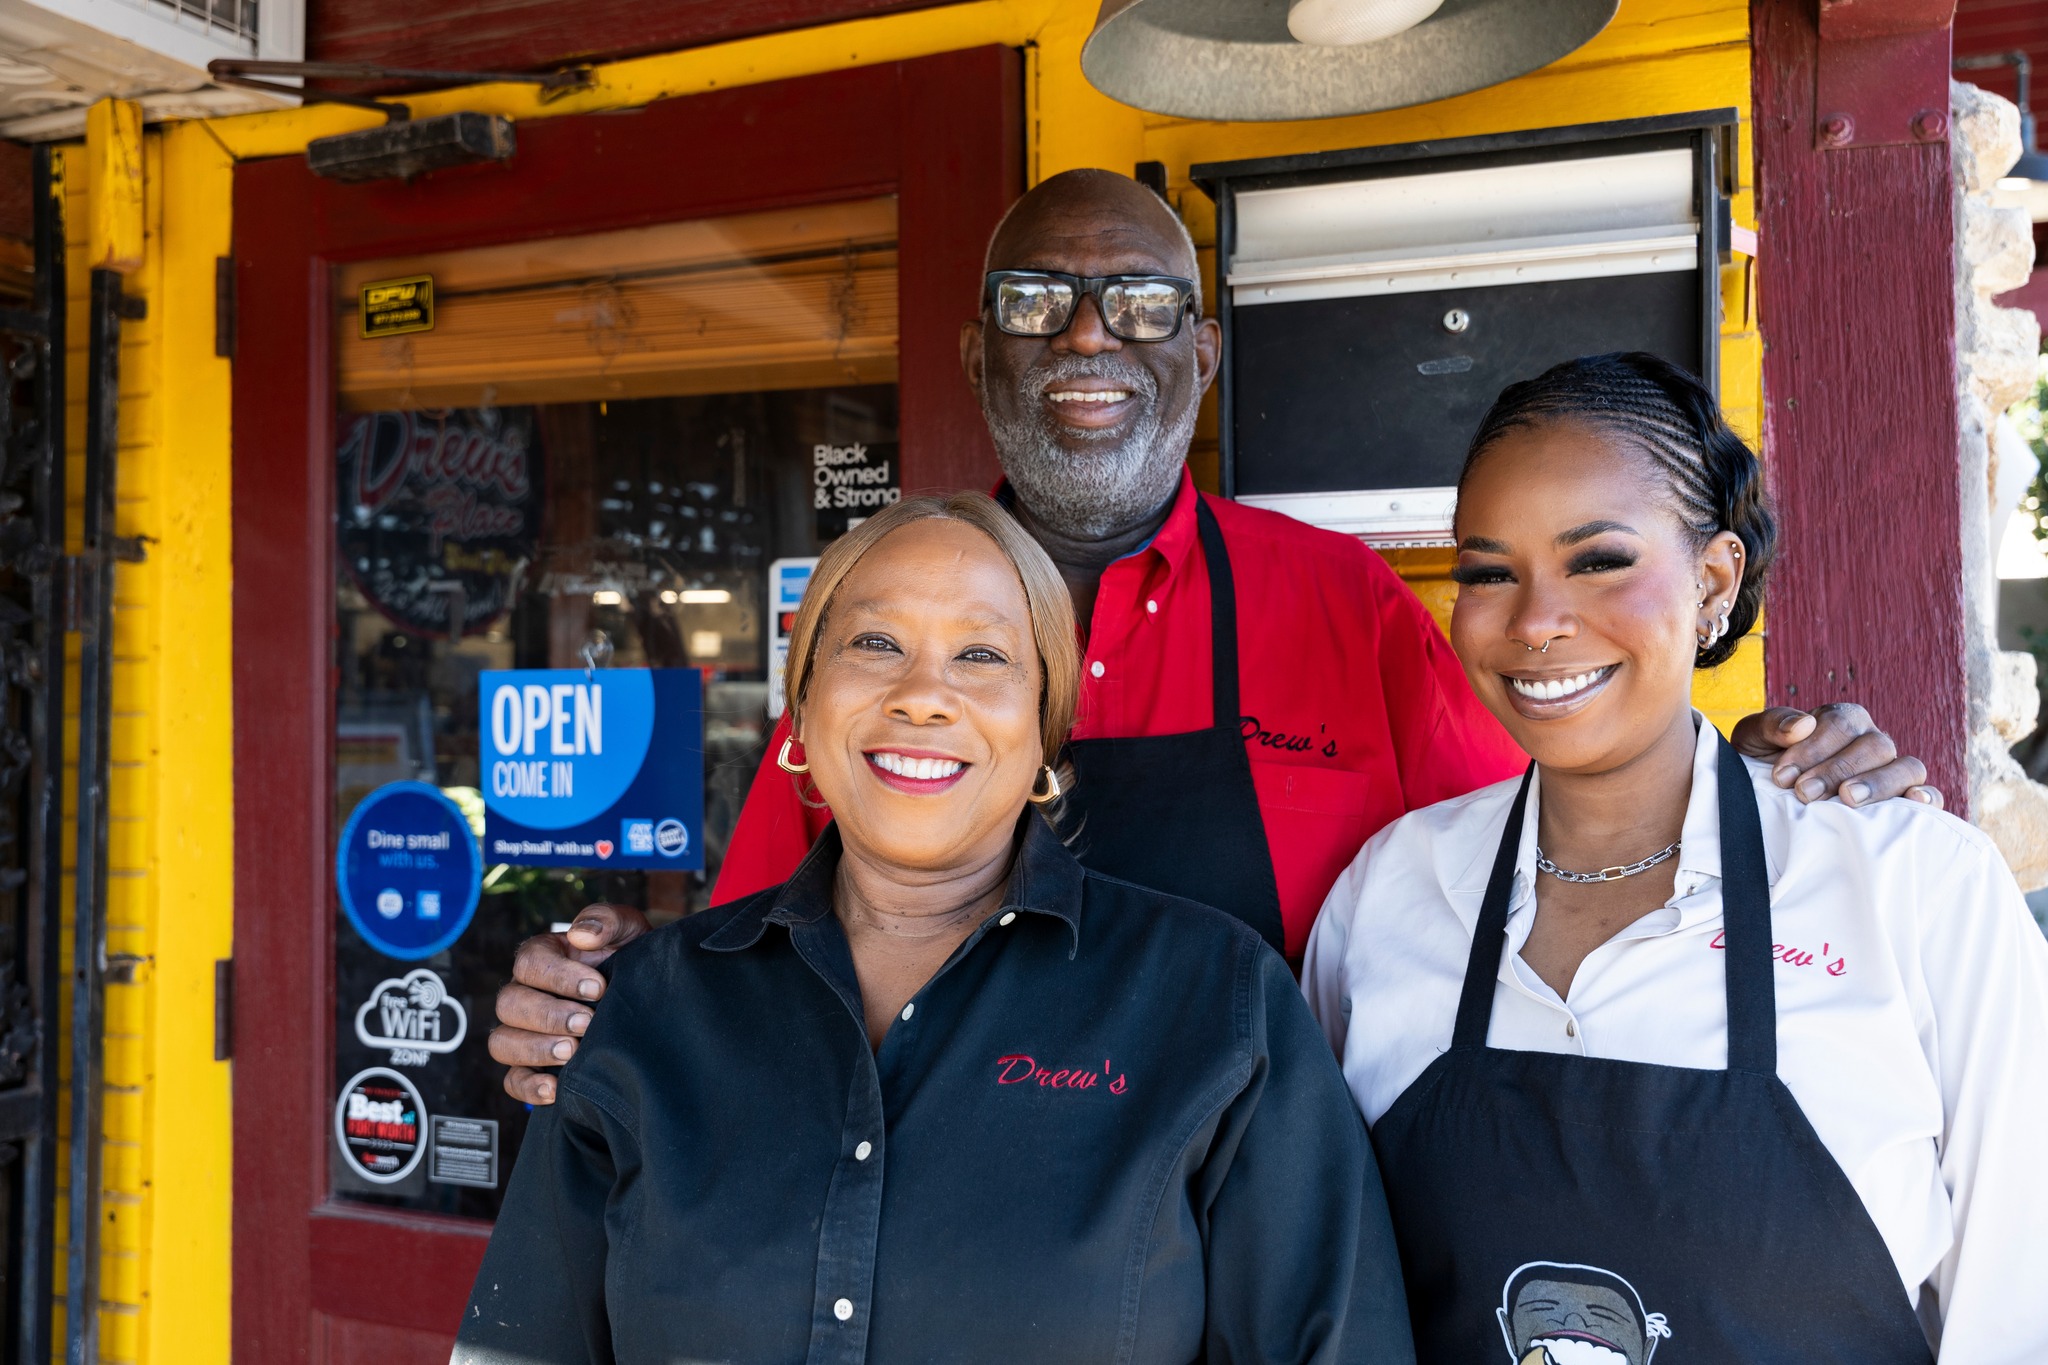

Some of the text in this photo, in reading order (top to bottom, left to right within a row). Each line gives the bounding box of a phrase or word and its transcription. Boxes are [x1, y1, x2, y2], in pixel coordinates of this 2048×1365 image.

[813, 442, 868, 467] Black
[813, 460, 889, 488] Owned
[814, 487, 831, 510] &
[491, 684, 602, 757] OPEN
[1239, 716, 1338, 758] Drew's
[492, 760, 574, 798] COME IN
[367, 829, 450, 851] Dine small
[493, 839, 523, 857] Shop
[554, 841, 581, 856] with
[580, 843, 595, 856] us
[379, 850, 413, 869] with
[380, 992, 408, 1009] free
[380, 1007, 440, 1041] WiFi
[997, 1054, 1128, 1095] Drew's
[347, 1093, 404, 1126] Best
